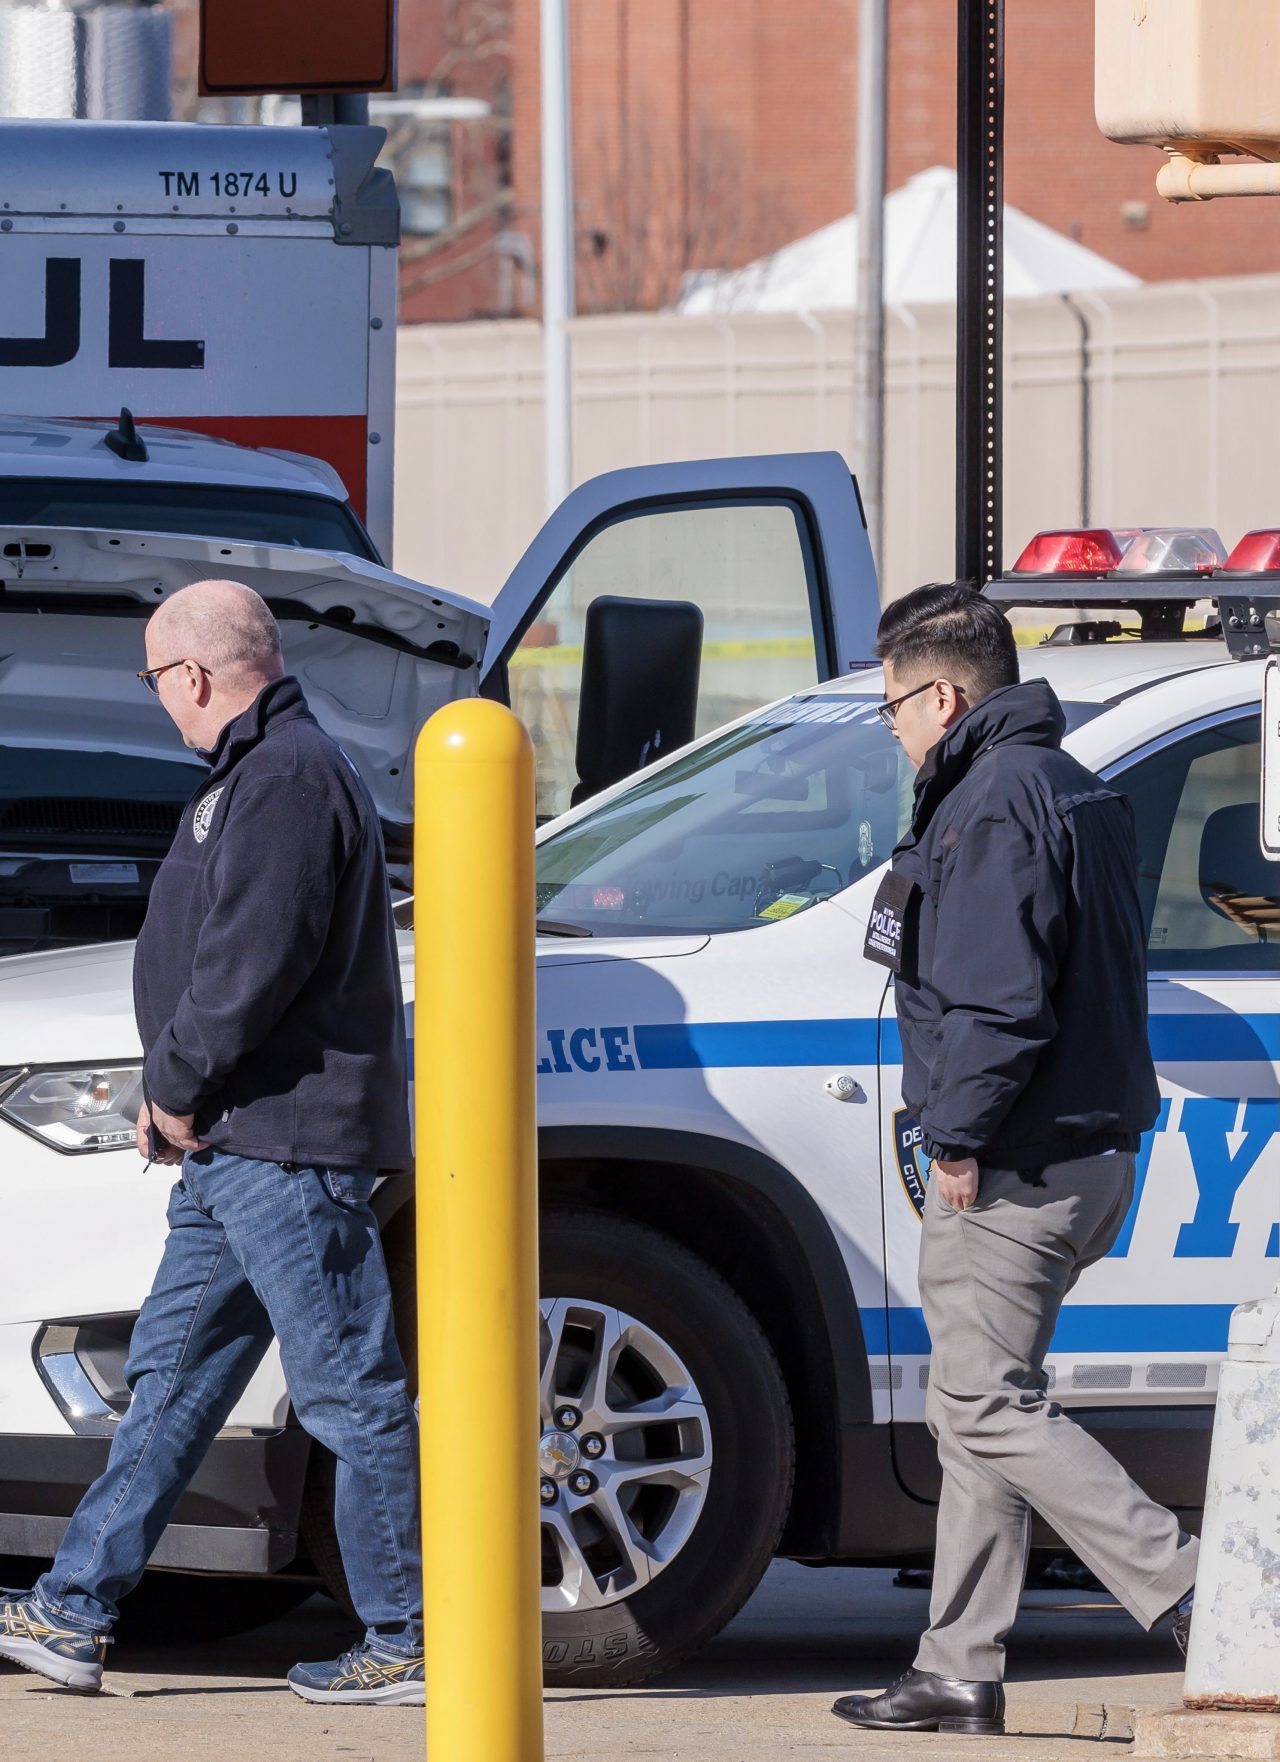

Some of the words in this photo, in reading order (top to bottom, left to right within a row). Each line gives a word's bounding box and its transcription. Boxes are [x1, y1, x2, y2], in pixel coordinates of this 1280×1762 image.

[158, 171, 199, 197] TM
[209, 171, 270, 197] 1874
[279, 172, 297, 198] U
[870, 909, 902, 941] POLICE
[903, 1163, 925, 1200] CITY
